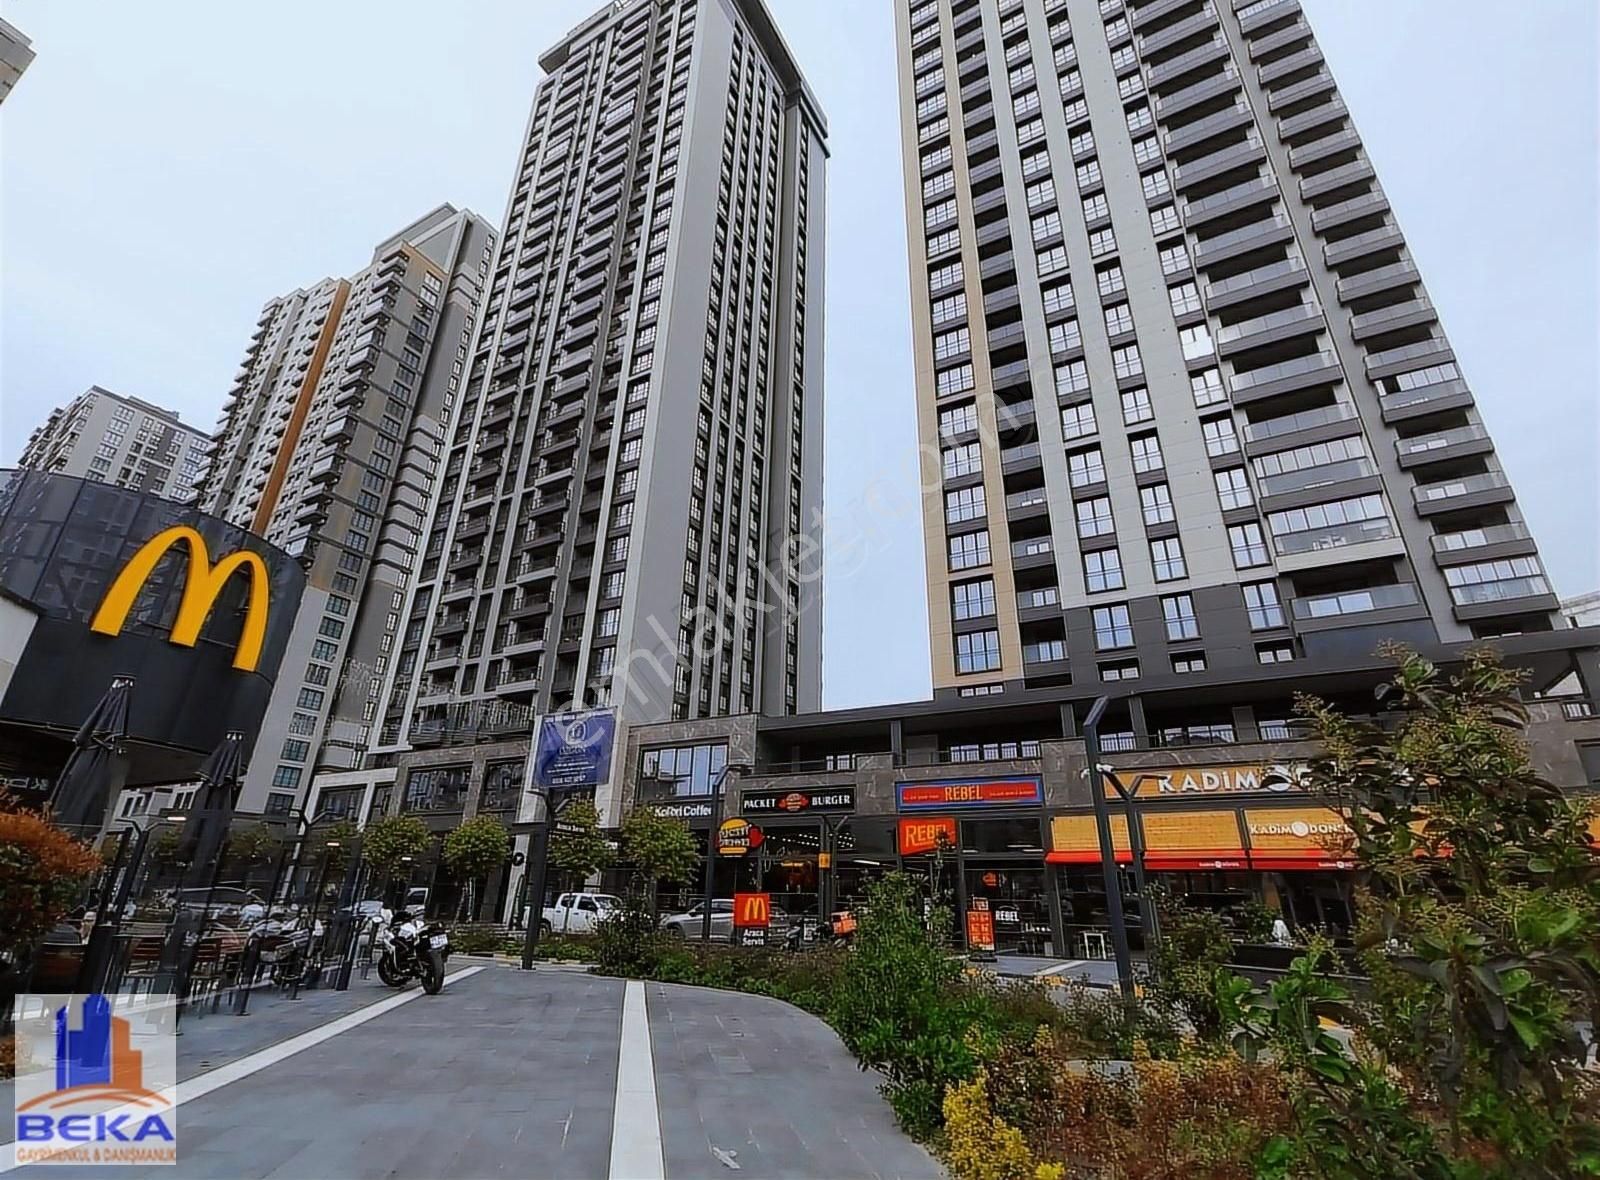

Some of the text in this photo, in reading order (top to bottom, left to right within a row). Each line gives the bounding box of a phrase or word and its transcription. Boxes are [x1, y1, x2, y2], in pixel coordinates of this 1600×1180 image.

[944, 784, 983, 801] REBEL
[744, 794, 850, 809] PACKET BURGER
[995, 910, 1020, 922] REBEL
[743, 928, 764, 937] Araca
[742, 937, 764, 946] Servis
